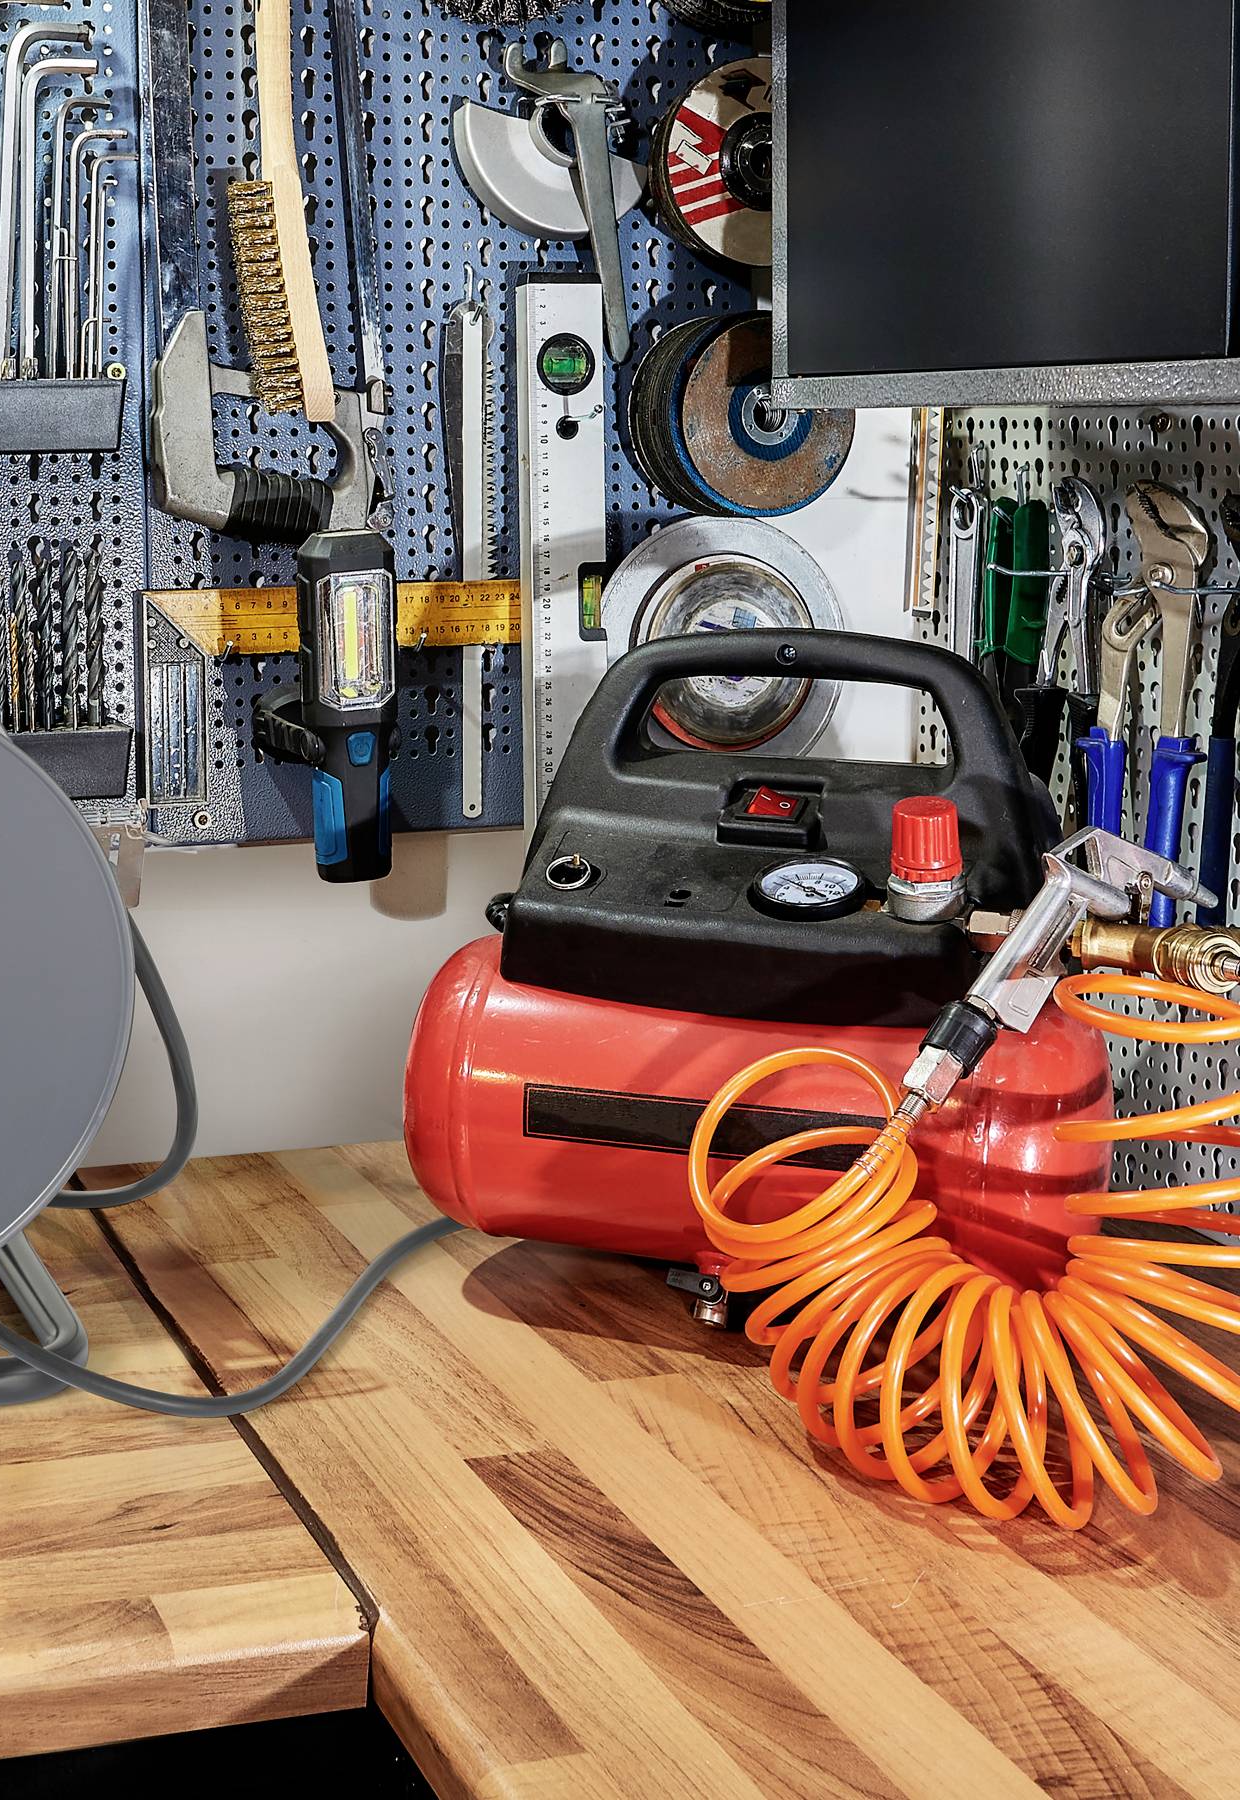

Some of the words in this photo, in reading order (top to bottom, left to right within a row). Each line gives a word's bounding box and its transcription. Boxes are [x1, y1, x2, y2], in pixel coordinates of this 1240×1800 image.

[540, 434, 548, 444] 10
[542, 452, 548, 460] 11
[542, 468, 549, 476] 12
[542, 485, 550, 493] 13
[543, 501, 550, 509] 14
[543, 518, 550, 526] 15
[543, 534, 550, 542] 16
[544, 551, 550, 559] 17
[543, 567, 550, 575] 18
[543, 583, 551, 592] 19
[220, 602, 225, 610] 5
[235, 602, 241, 610] 6
[250, 601, 257, 609] 7
[266, 601, 272, 609] 8
[282, 600, 288, 608] 9
[404, 596, 414, 604] 17
[420, 596, 430, 604] 18
[435, 595, 445, 603] 19
[450, 595, 460, 603] 20
[480, 593, 490, 601] 22
[495, 593, 505, 601] 23
[542, 598, 551, 609] 20
[544, 616, 551, 624] 21
[251, 633, 257, 641] 3
[266, 632, 272, 640] 4
[282, 632, 288, 640] 5
[420, 626, 429, 634] 14
[450, 625, 460, 633] 16
[481, 624, 490, 632] 18
[509, 623, 520, 631] 20
[544, 632, 551, 640] 22
[544, 649, 552, 657] 23
[545, 665, 552, 673] 24
[545, 681, 552, 690] 25
[546, 698, 552, 706] 26
[546, 714, 552, 722] 27
[546, 730, 552, 739] 28
[546, 747, 553, 755] 29
[544, 762, 553, 773] 30
